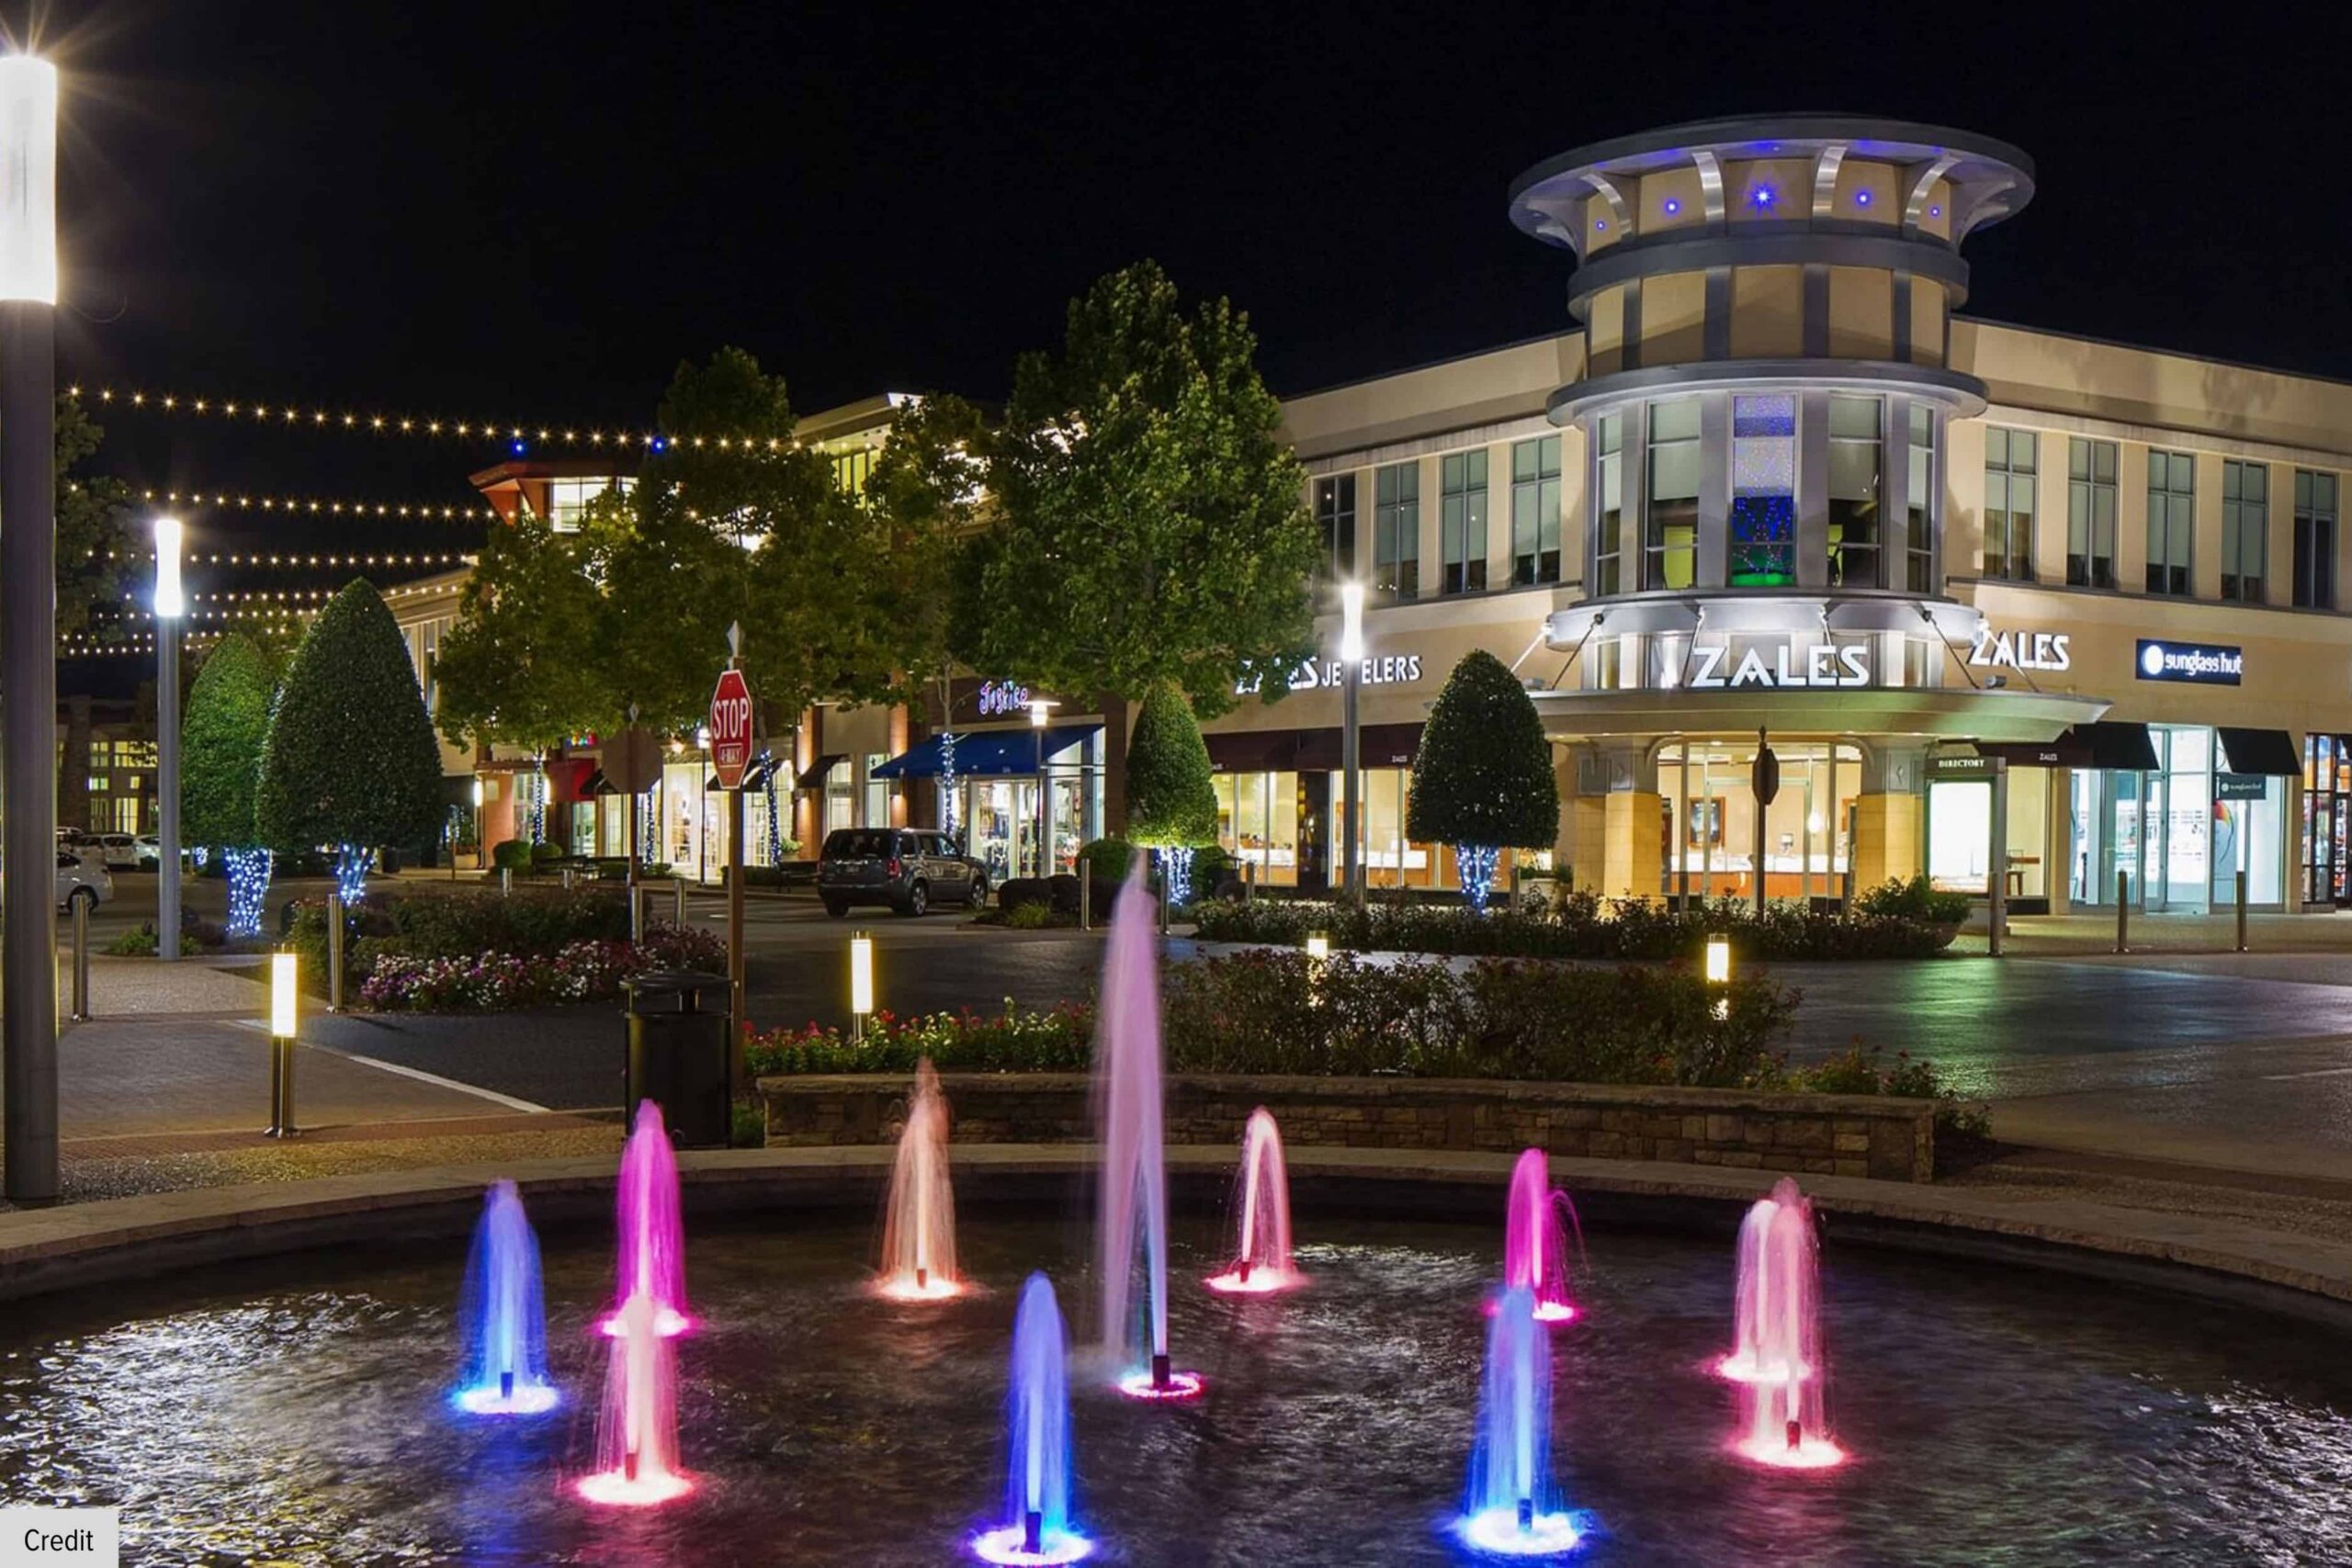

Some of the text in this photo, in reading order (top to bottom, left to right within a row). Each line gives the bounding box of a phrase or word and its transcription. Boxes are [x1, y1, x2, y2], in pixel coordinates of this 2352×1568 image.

[1690, 645, 1871, 688] ZALES
[1967, 632, 2070, 671] ZALES
[2165, 649, 2243, 676] sunglass hut
[1321, 655, 1420, 687] JEELERS
[978, 680, 1029, 716] Justice
[713, 697, 749, 740] STOP
[1938, 760, 1984, 768] DIRECTORY
